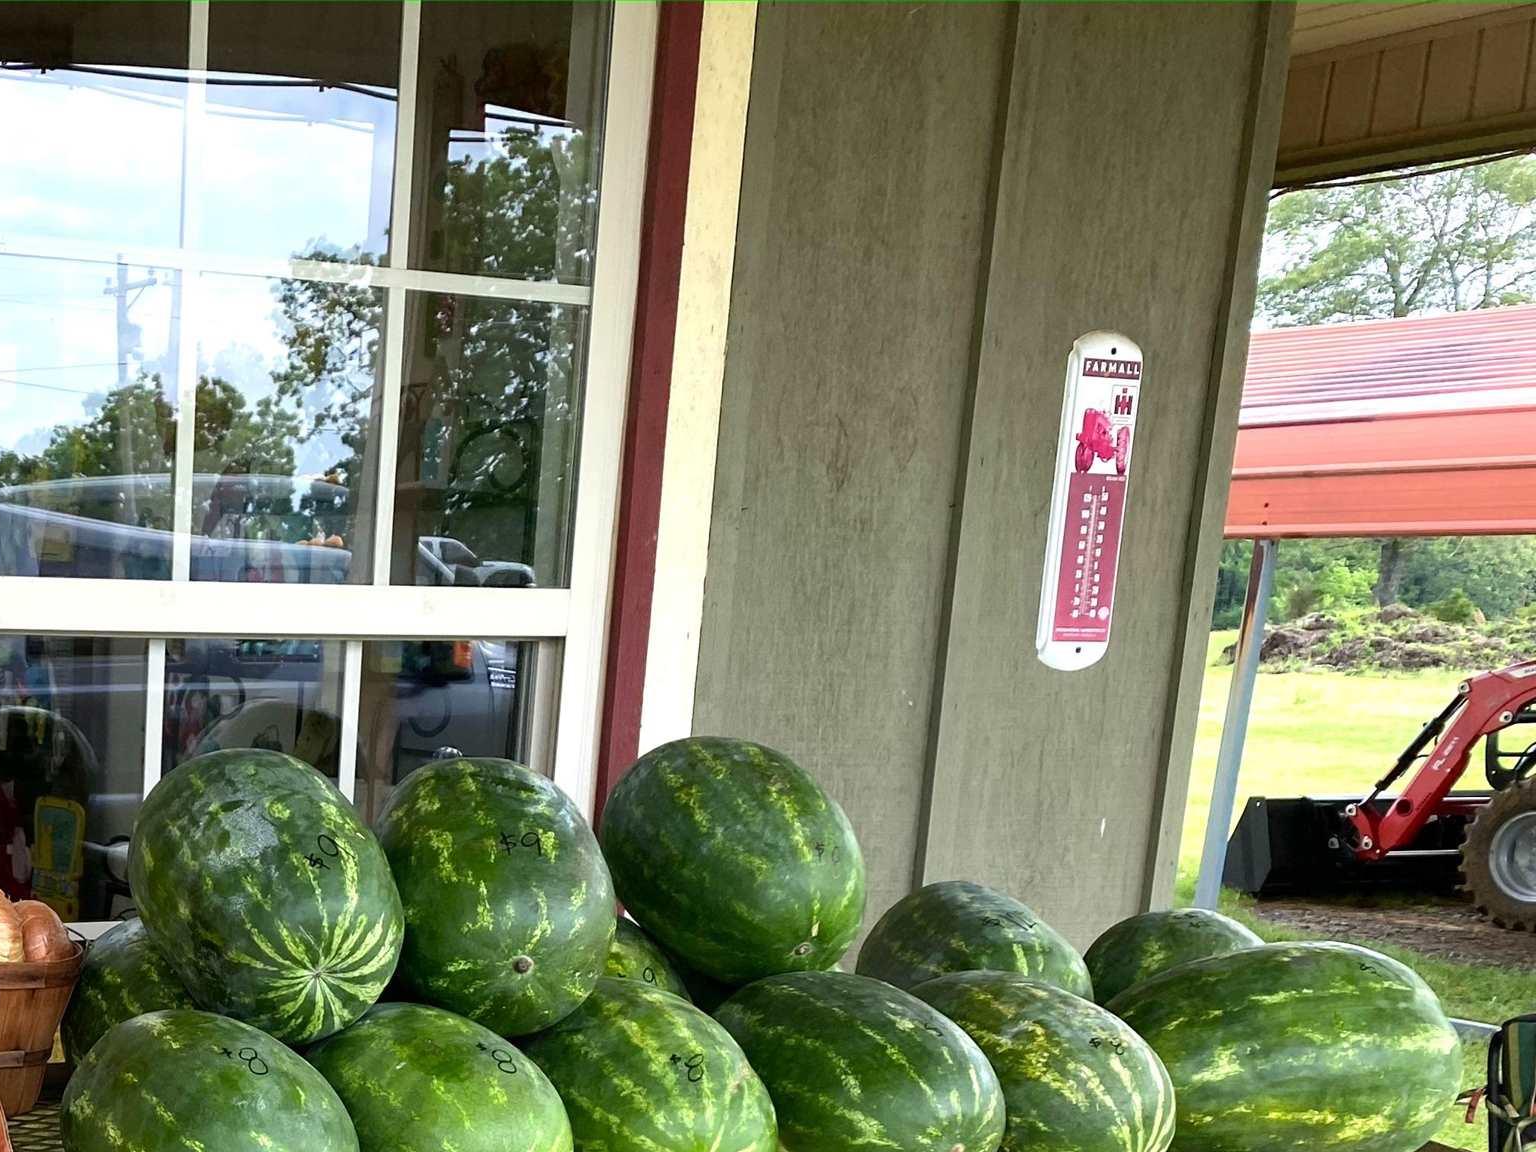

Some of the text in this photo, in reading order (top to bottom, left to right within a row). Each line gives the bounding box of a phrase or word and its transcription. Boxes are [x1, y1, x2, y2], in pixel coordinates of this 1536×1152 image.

[1085, 360, 1140, 375] FARMALL
[499, 831, 542, 857] $9
[220, 1047, 269, 1075] $8
[475, 1043, 517, 1074] $8
